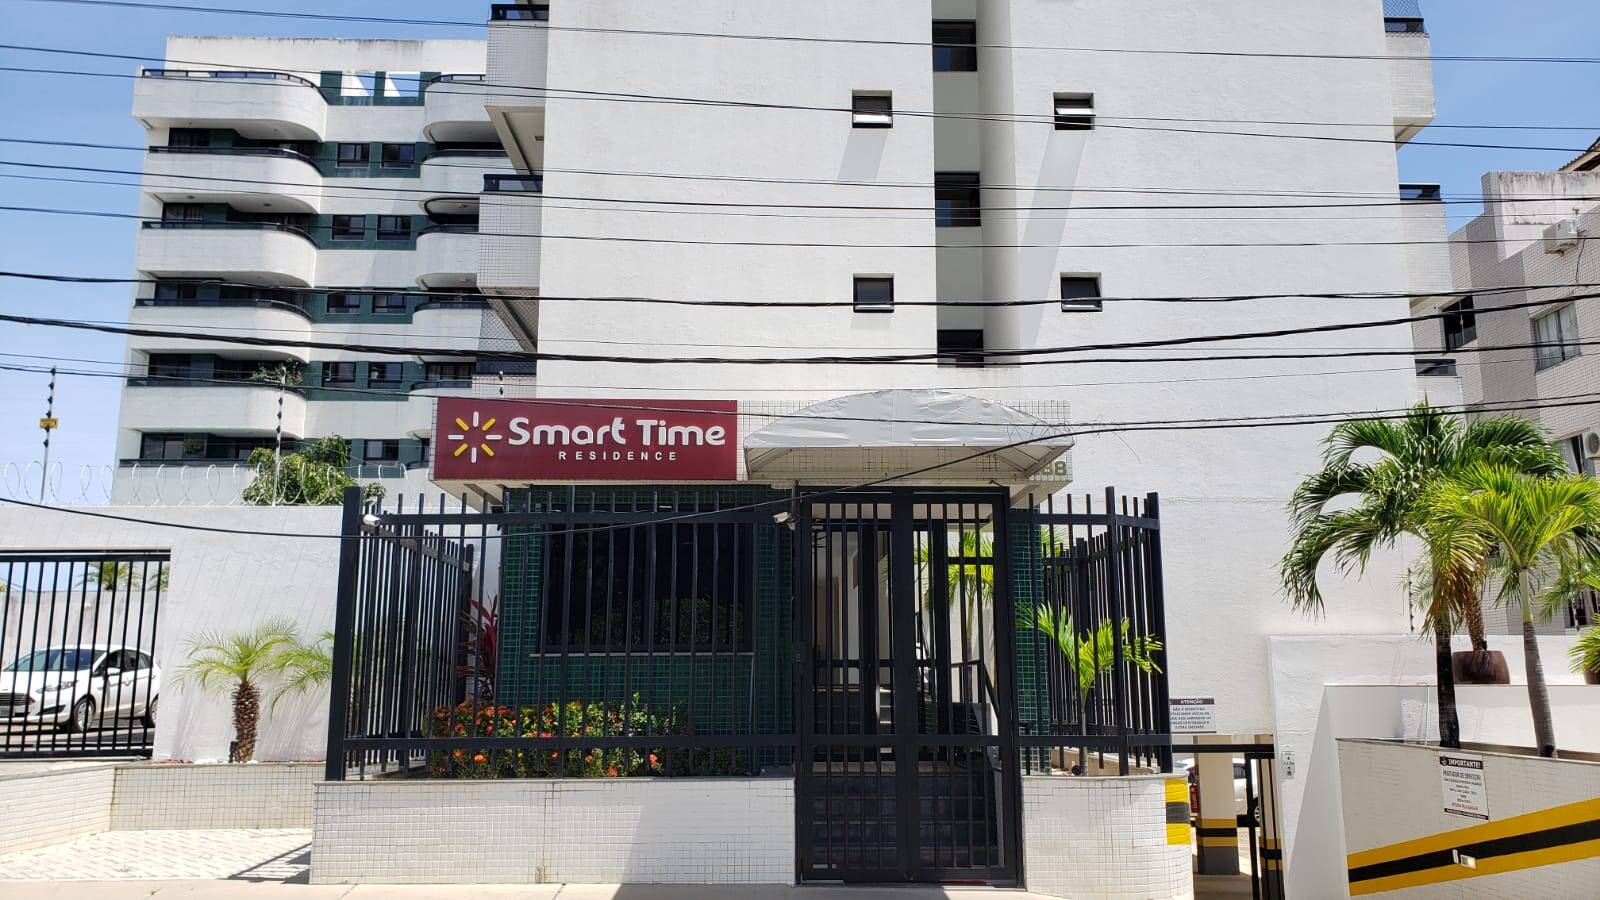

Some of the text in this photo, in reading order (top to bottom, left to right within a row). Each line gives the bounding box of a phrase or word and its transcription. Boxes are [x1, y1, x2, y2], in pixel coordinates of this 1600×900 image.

[508, 416, 726, 446] Smart Time
[558, 451, 677, 461] RESIDENCE
